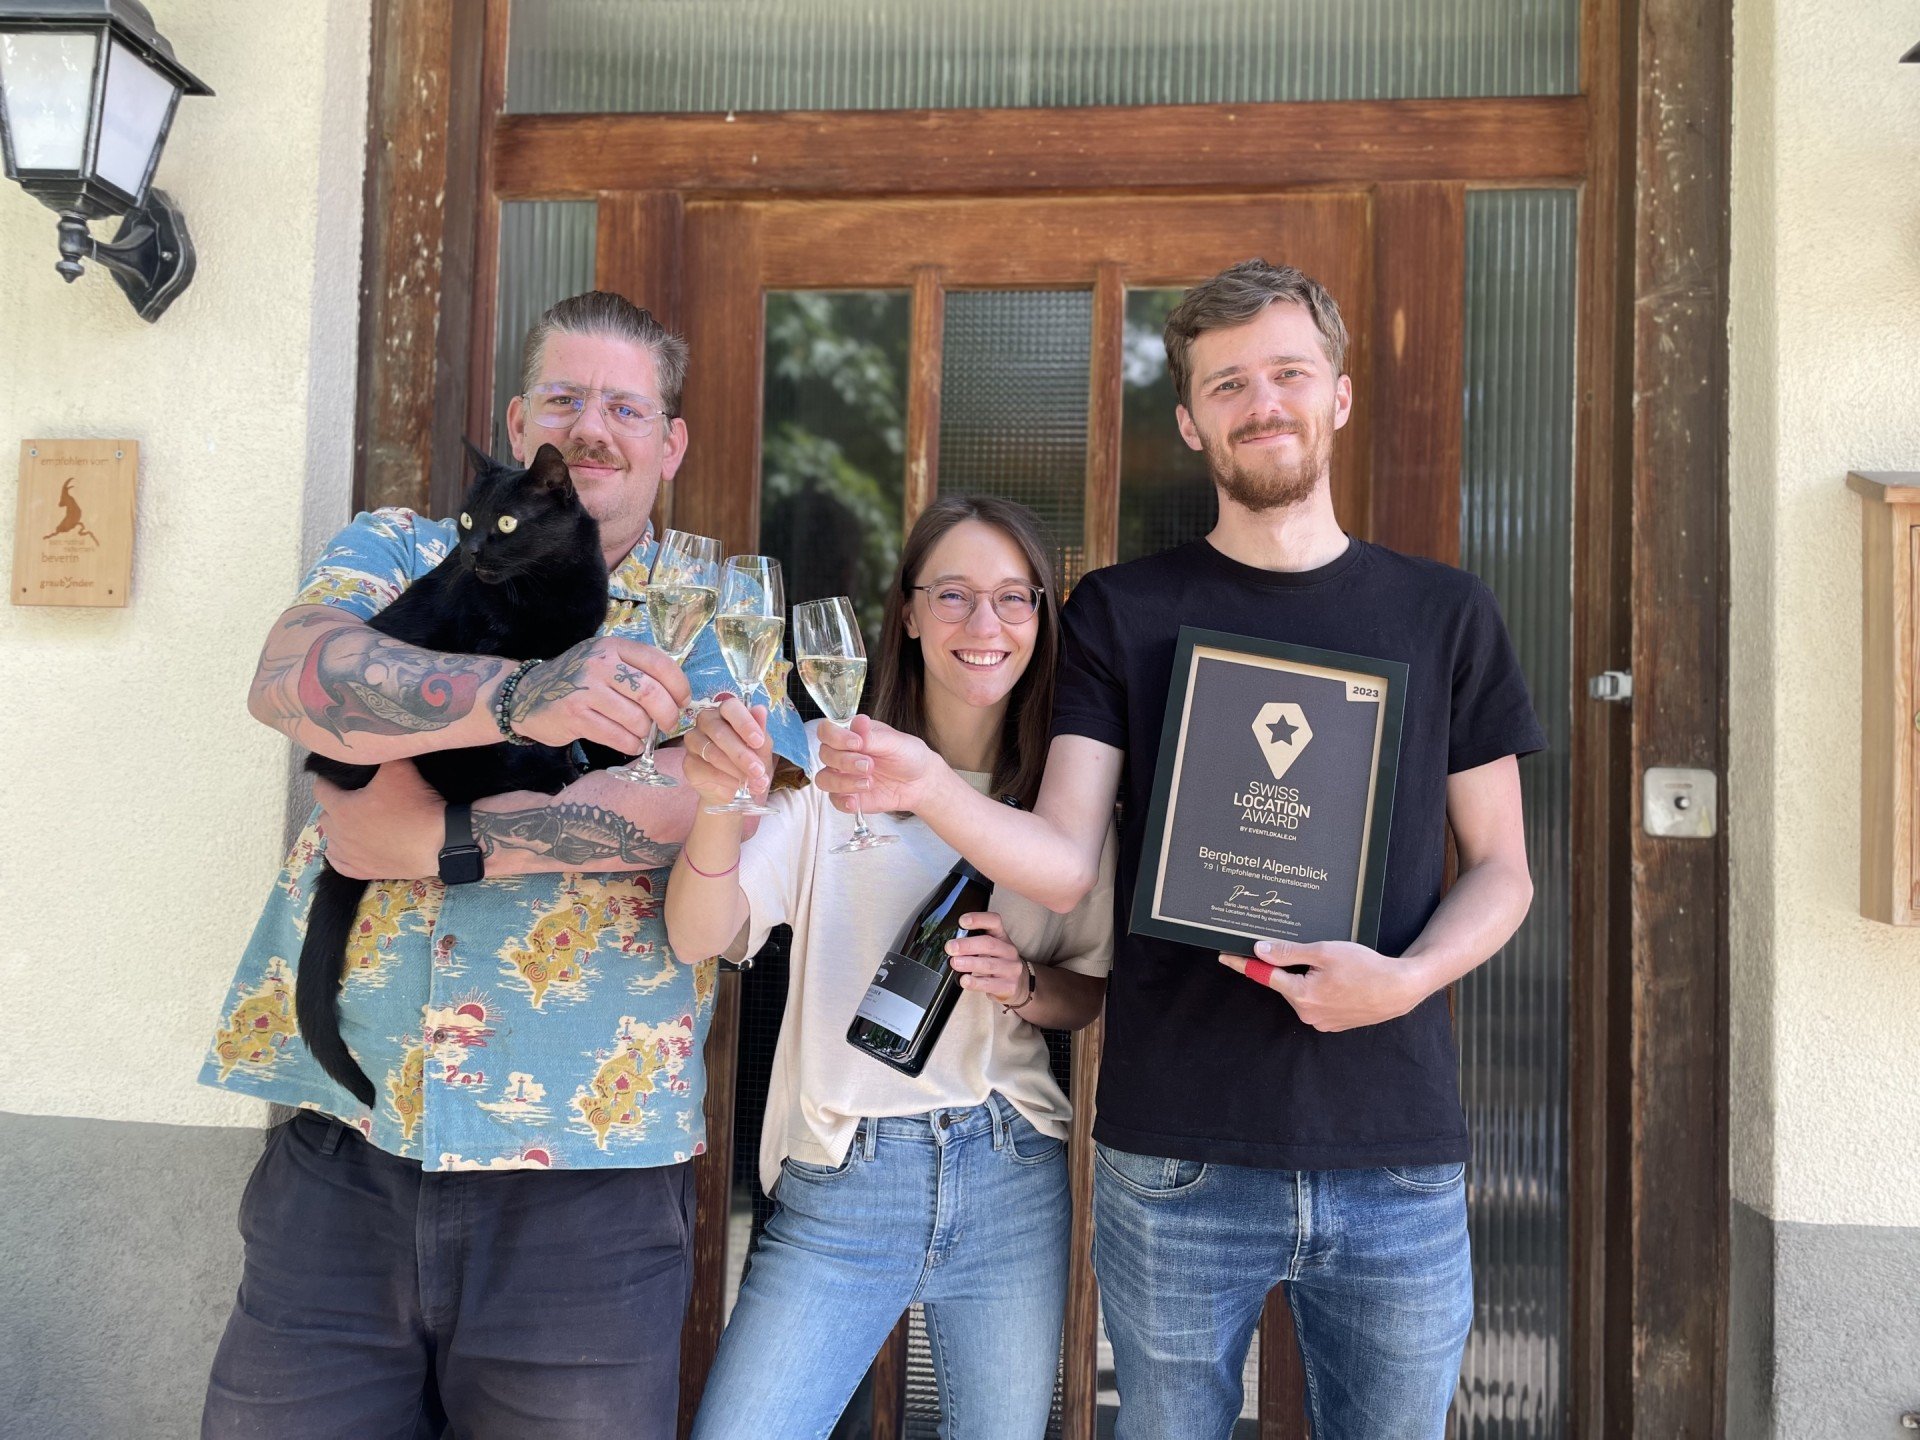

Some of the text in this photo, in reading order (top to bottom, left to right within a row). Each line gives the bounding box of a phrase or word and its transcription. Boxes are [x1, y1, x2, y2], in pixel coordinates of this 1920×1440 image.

[1352, 686, 1379, 698] 2023
[1249, 781, 1299, 802] SWISS
[1234, 792, 1311, 818] LOCATION
[1241, 808, 1299, 829] AWARD
[1248, 827, 1297, 841] EVENTLOKALE.CH
[1199, 846, 1328, 881] Berghotel Alpenblick
[1221, 866, 1261, 879] Empfohlene
[1261, 874, 1320, 890] Hochzeitslocation
[1210, 904, 1225, 912] Swiss
[1225, 907, 1246, 916] Location
